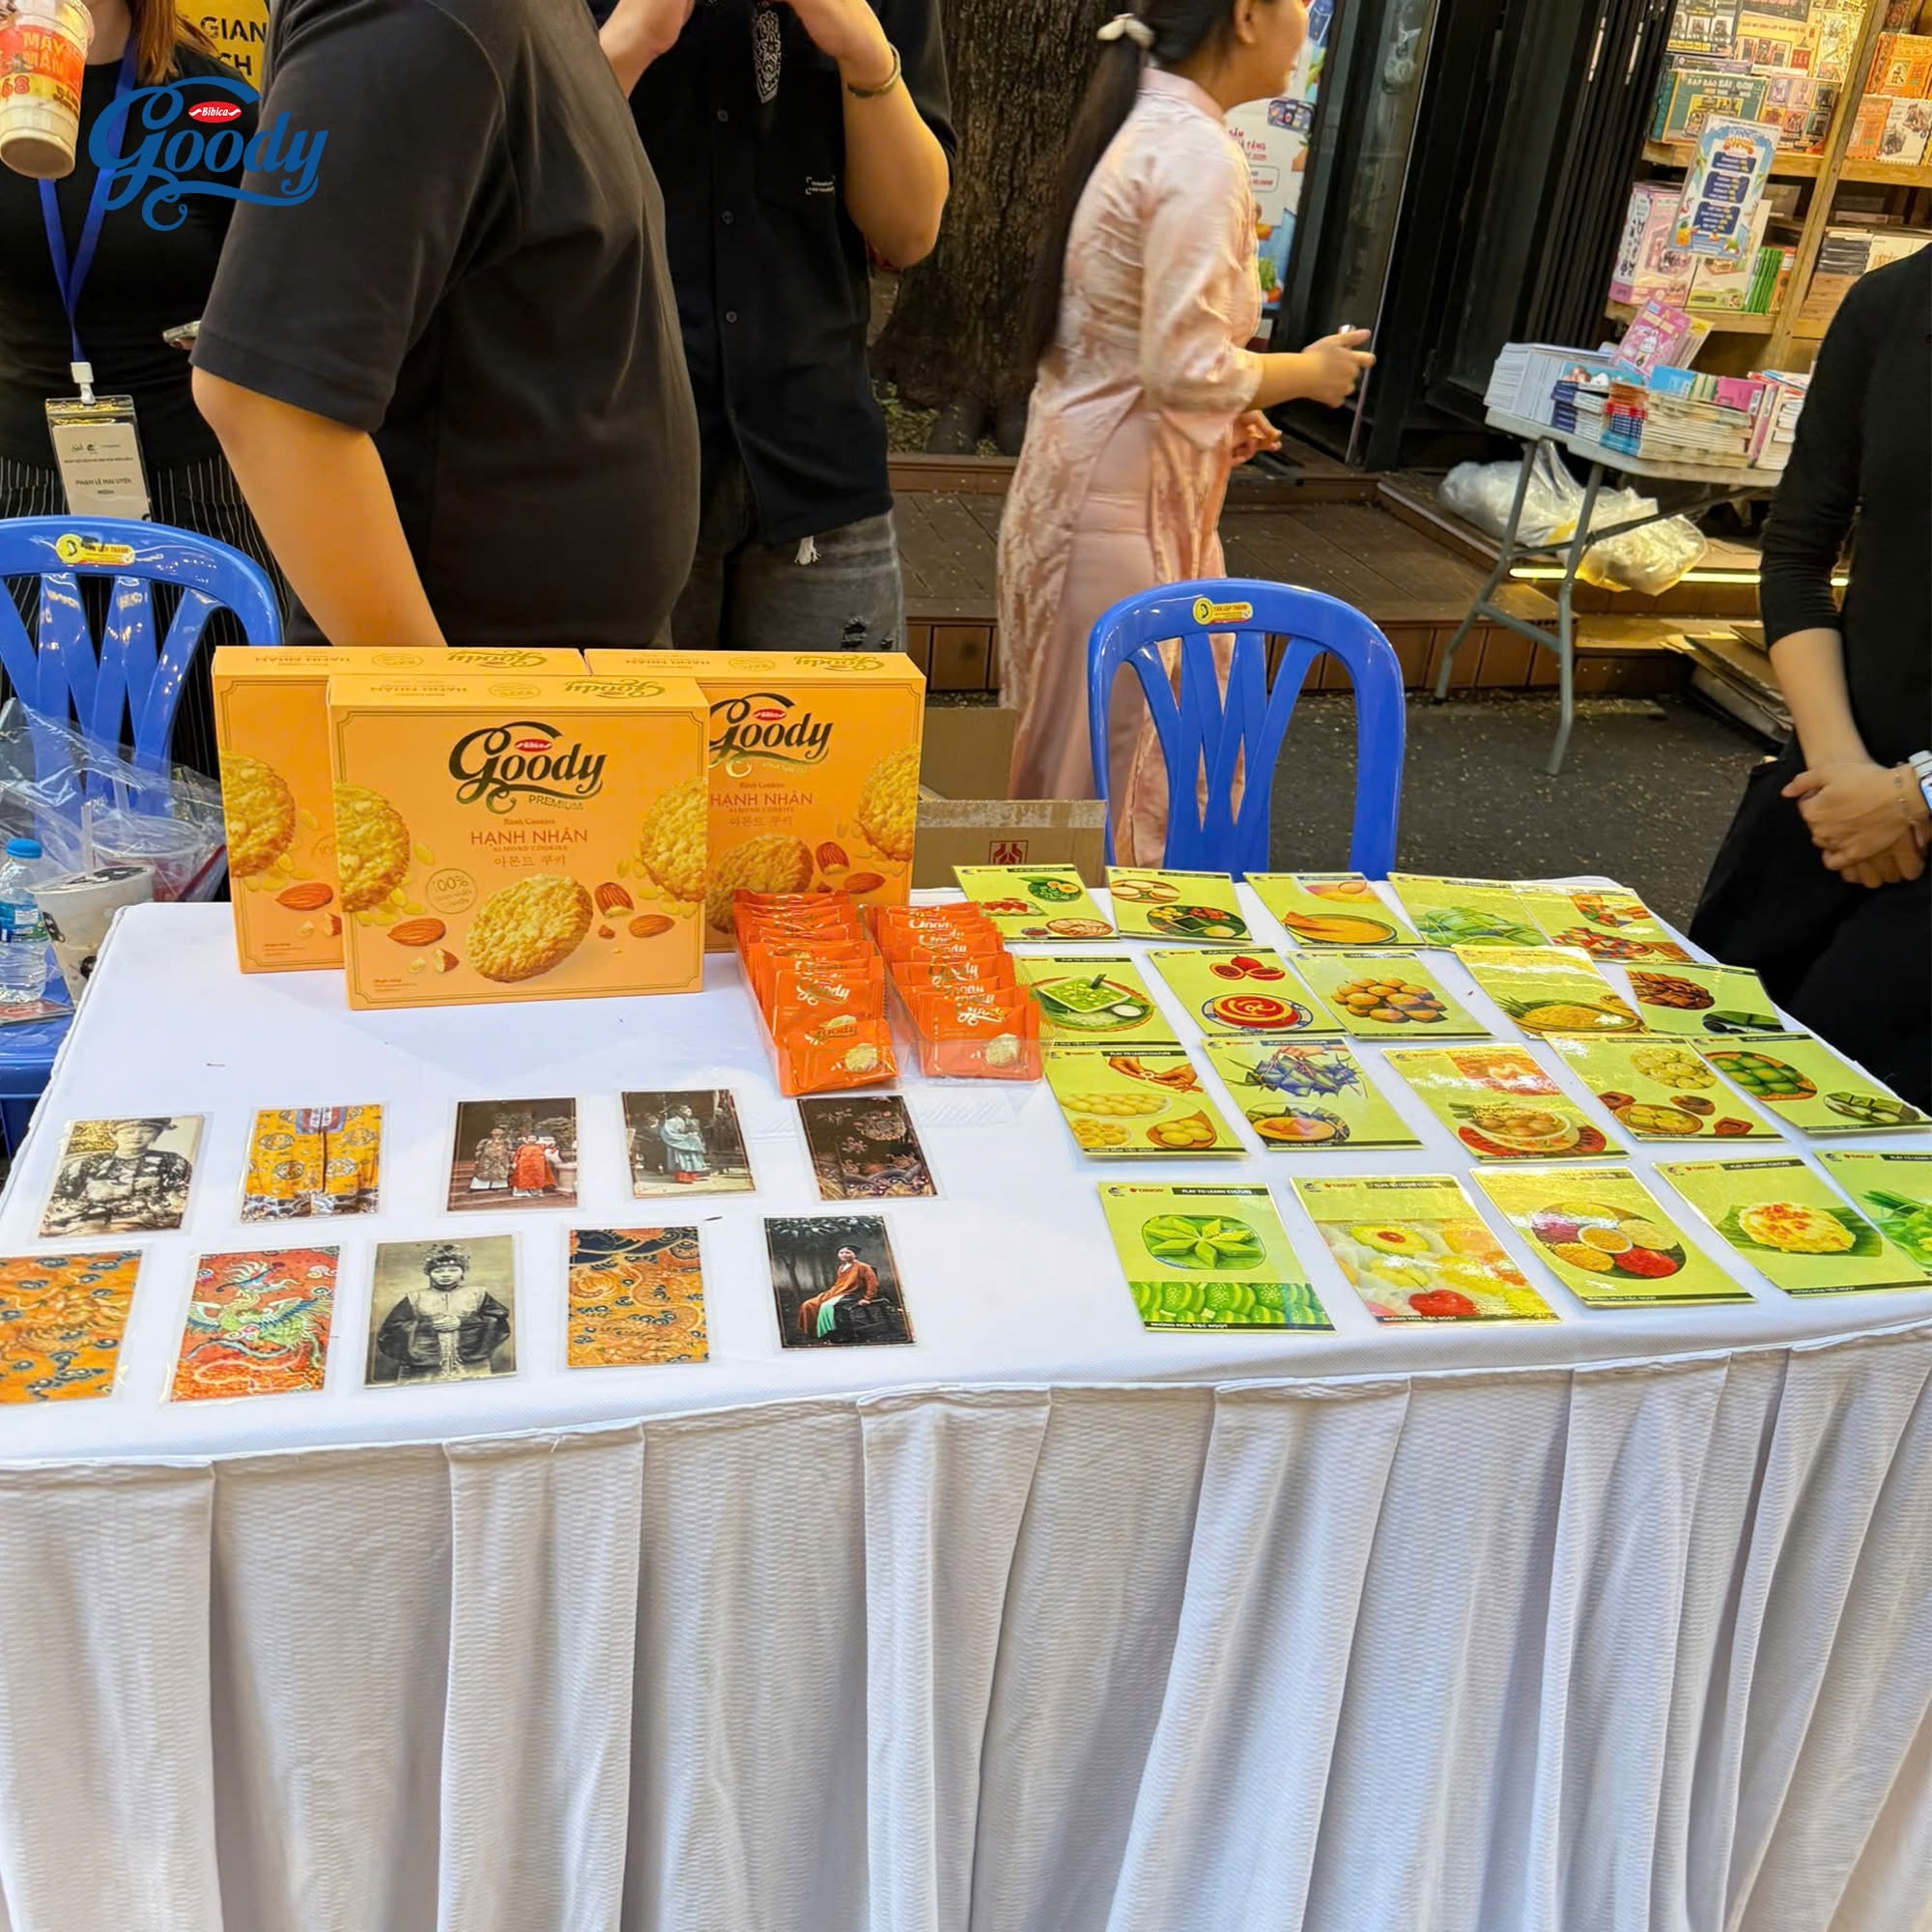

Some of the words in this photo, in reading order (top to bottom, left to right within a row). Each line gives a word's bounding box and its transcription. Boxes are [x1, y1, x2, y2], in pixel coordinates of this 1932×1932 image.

[448, 721, 608, 814] Goody
[709, 693, 834, 778] Goody
[528, 794, 584, 810] PREMIUM
